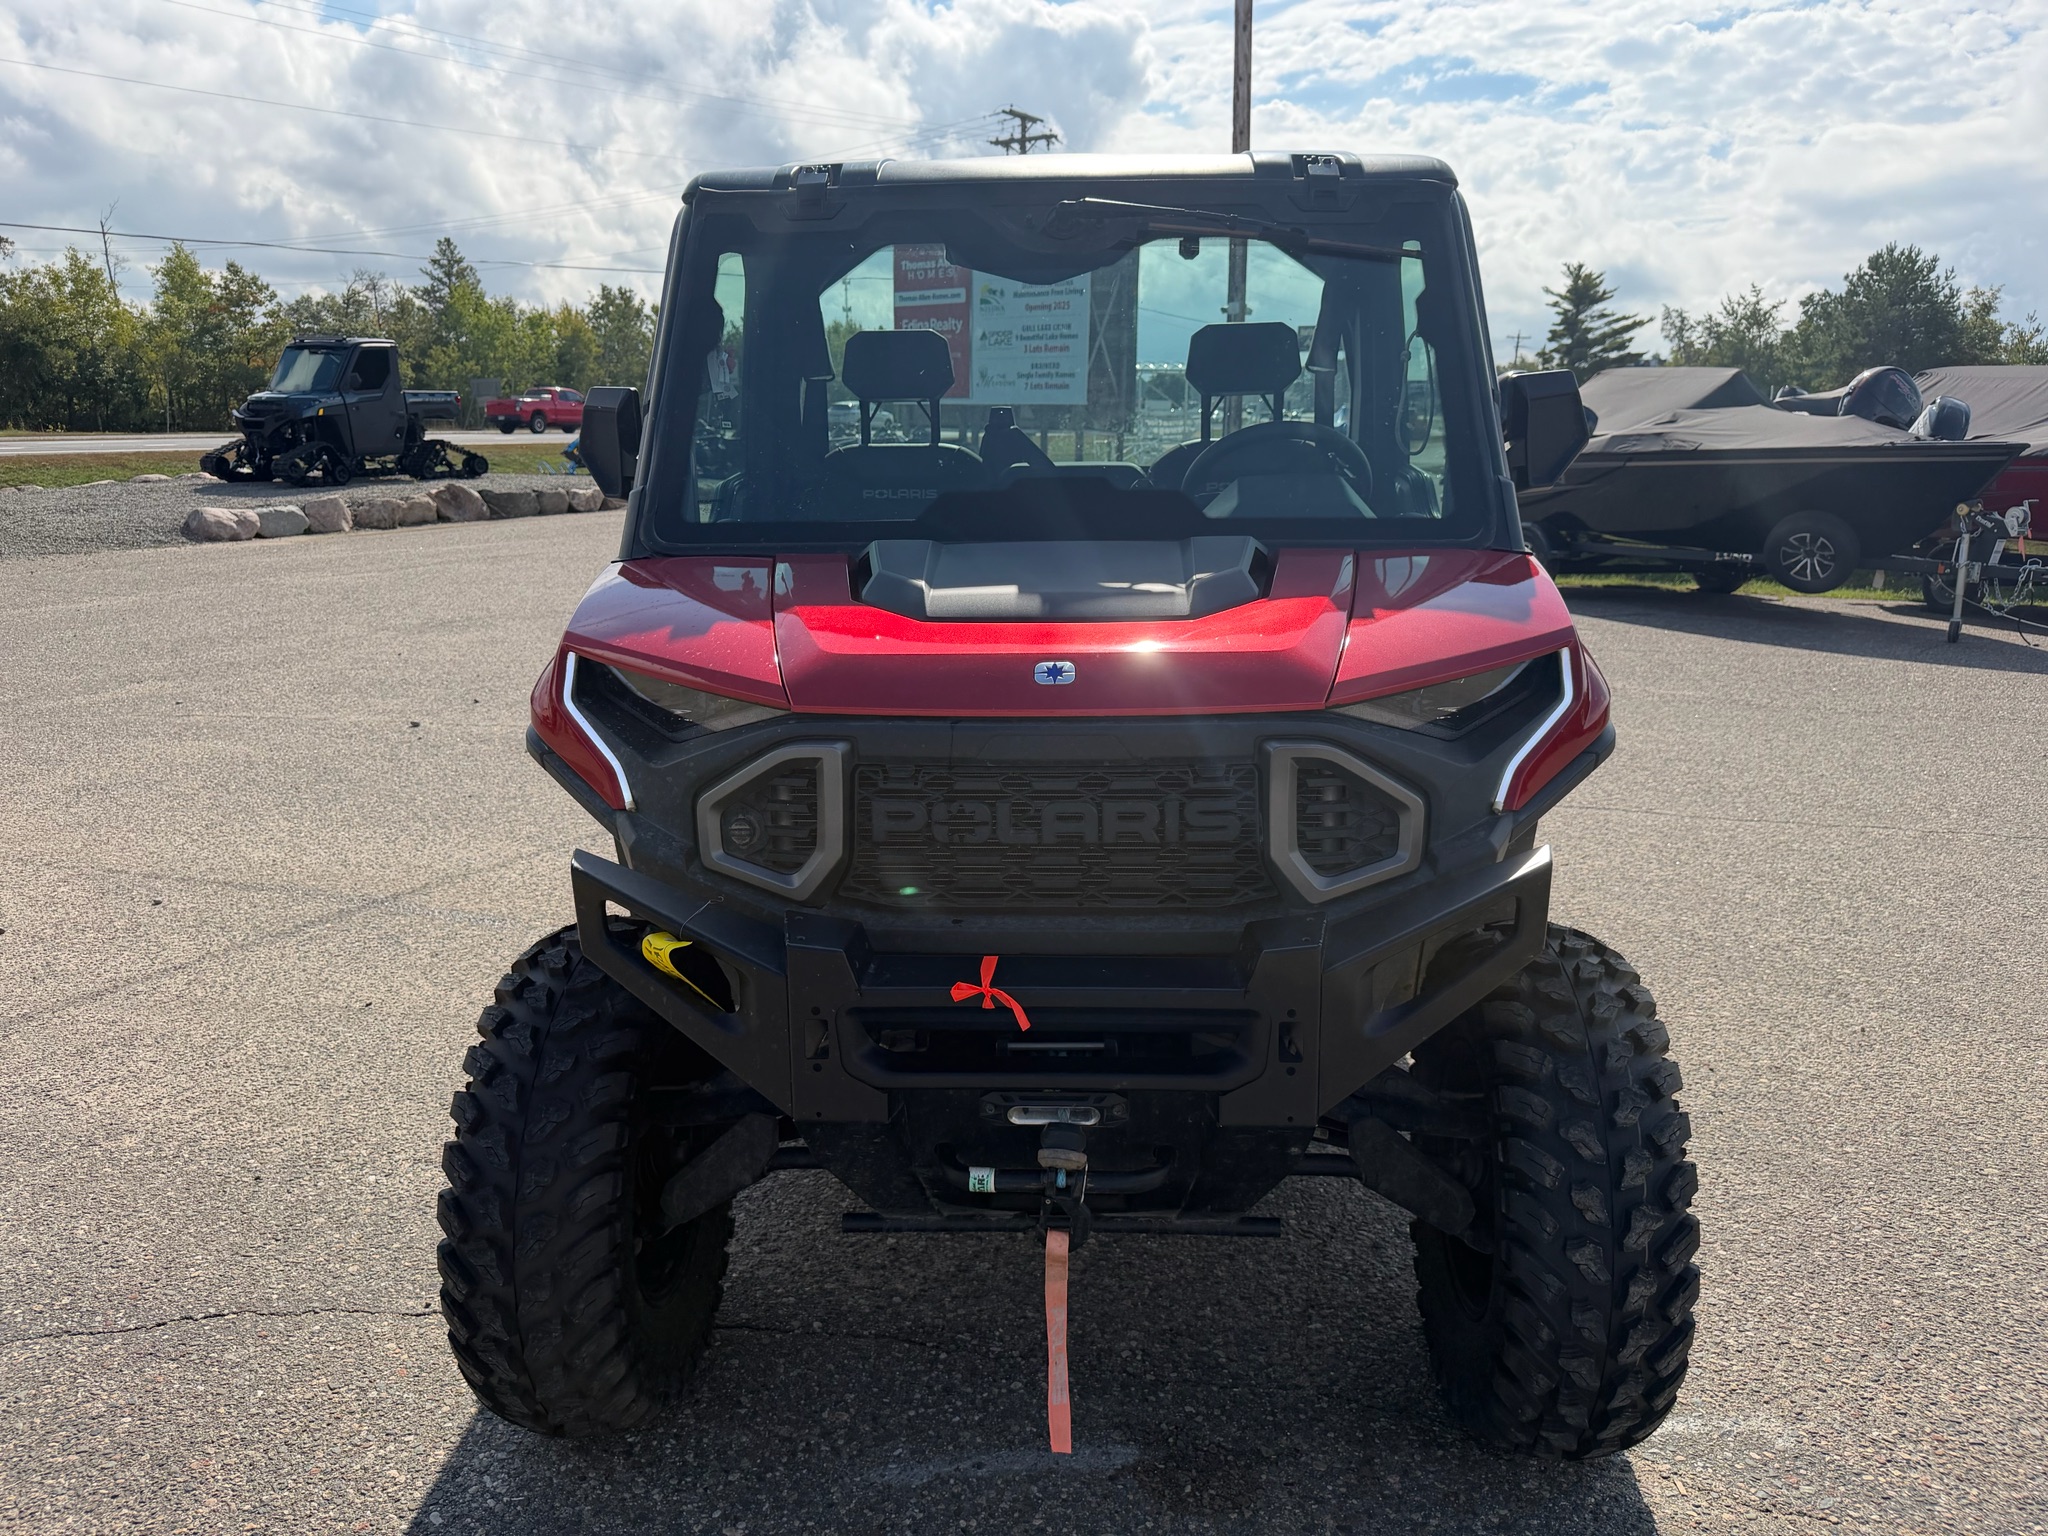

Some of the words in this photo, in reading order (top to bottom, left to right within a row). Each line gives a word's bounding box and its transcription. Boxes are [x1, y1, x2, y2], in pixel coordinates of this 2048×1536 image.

[901, 259, 936, 271] Thomas
[907, 266, 955, 281] HOMES
[1065, 288, 1084, 297] Living
[1025, 302, 1052, 312] Opening
[1053, 301, 1071, 310] 2025
[988, 337, 1013, 346] LAKE
[1029, 344, 1043, 353] Lots
[1044, 343, 1070, 353] Remain
[1030, 382, 1043, 390] Lots
[1044, 381, 1070, 390] Remain
[863, 489, 937, 499] POLARIS
[1714, 551, 1753, 563] LUND
[871, 799, 1242, 845] POLARIS
